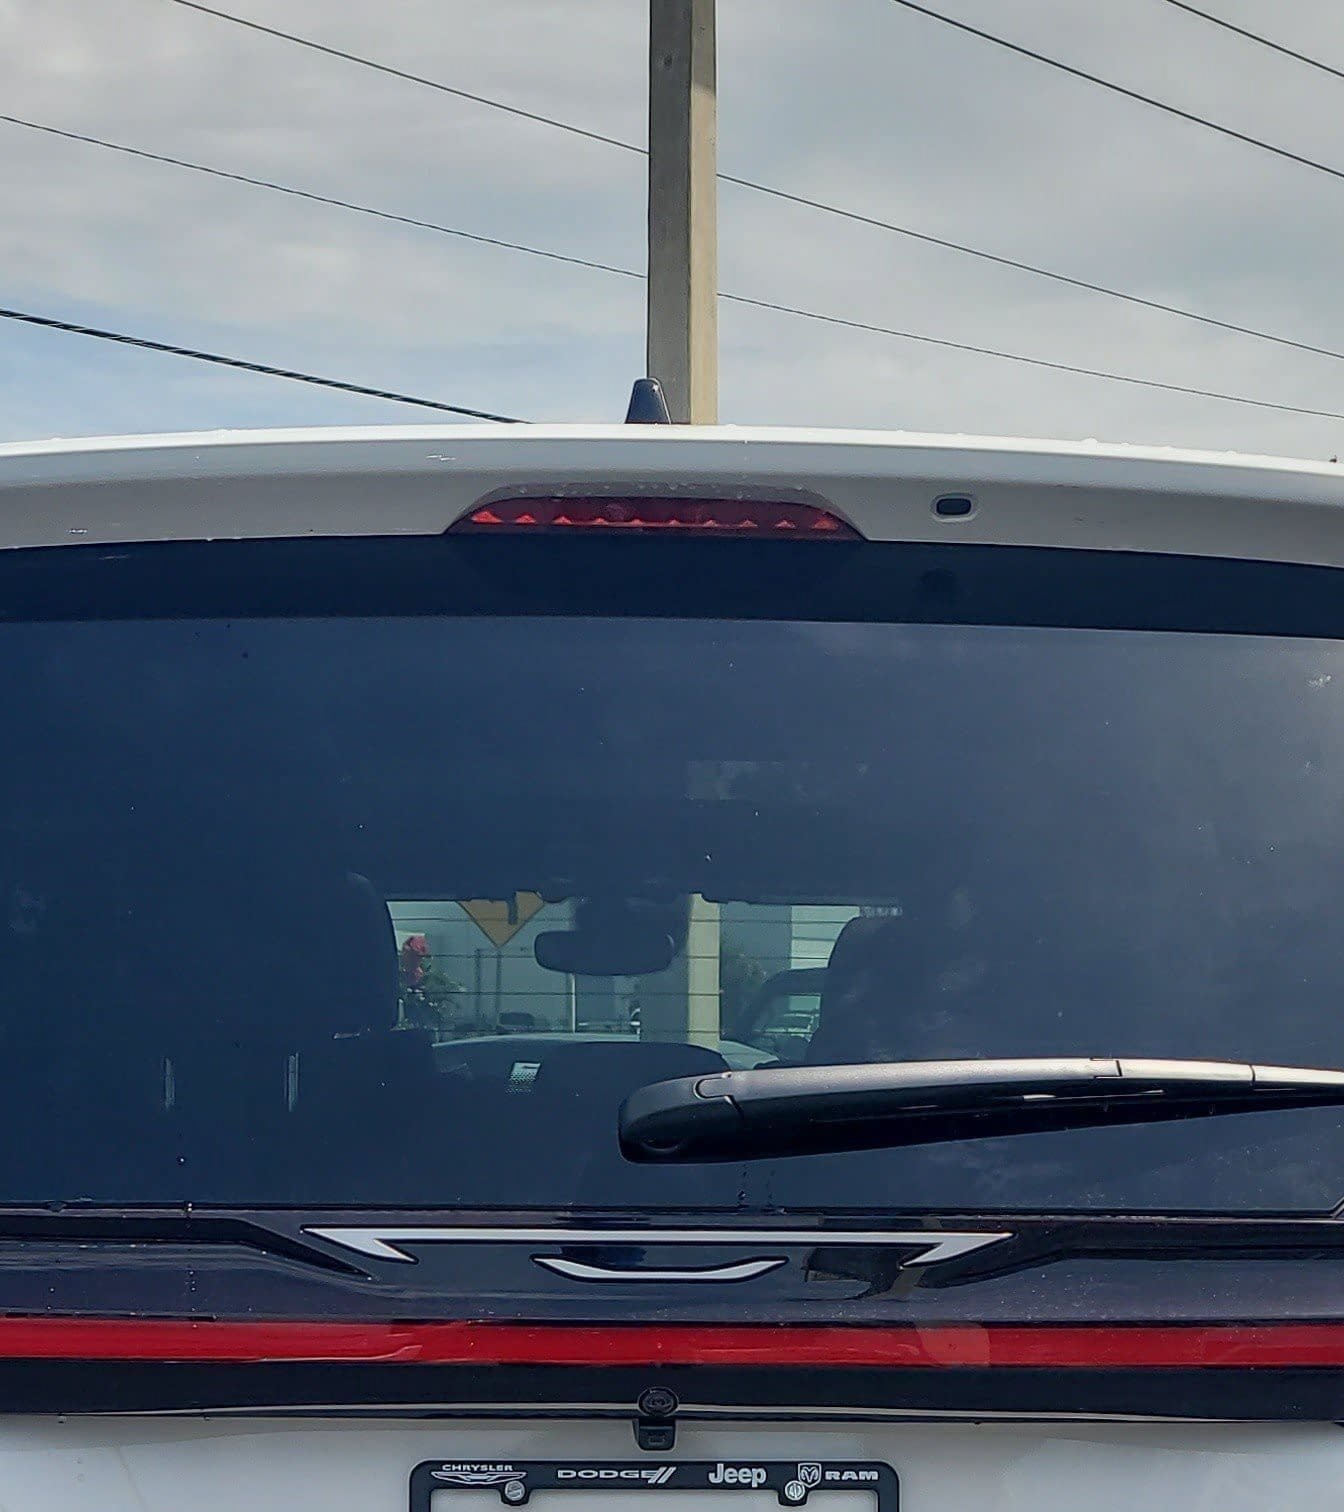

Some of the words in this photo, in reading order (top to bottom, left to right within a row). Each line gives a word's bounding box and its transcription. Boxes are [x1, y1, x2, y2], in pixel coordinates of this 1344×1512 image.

[442, 1463, 513, 1471] CHRYSLER
[557, 1469, 660, 1479] DODGE
[708, 1463, 767, 1487] Jeep
[824, 1470, 878, 1480] RAM
